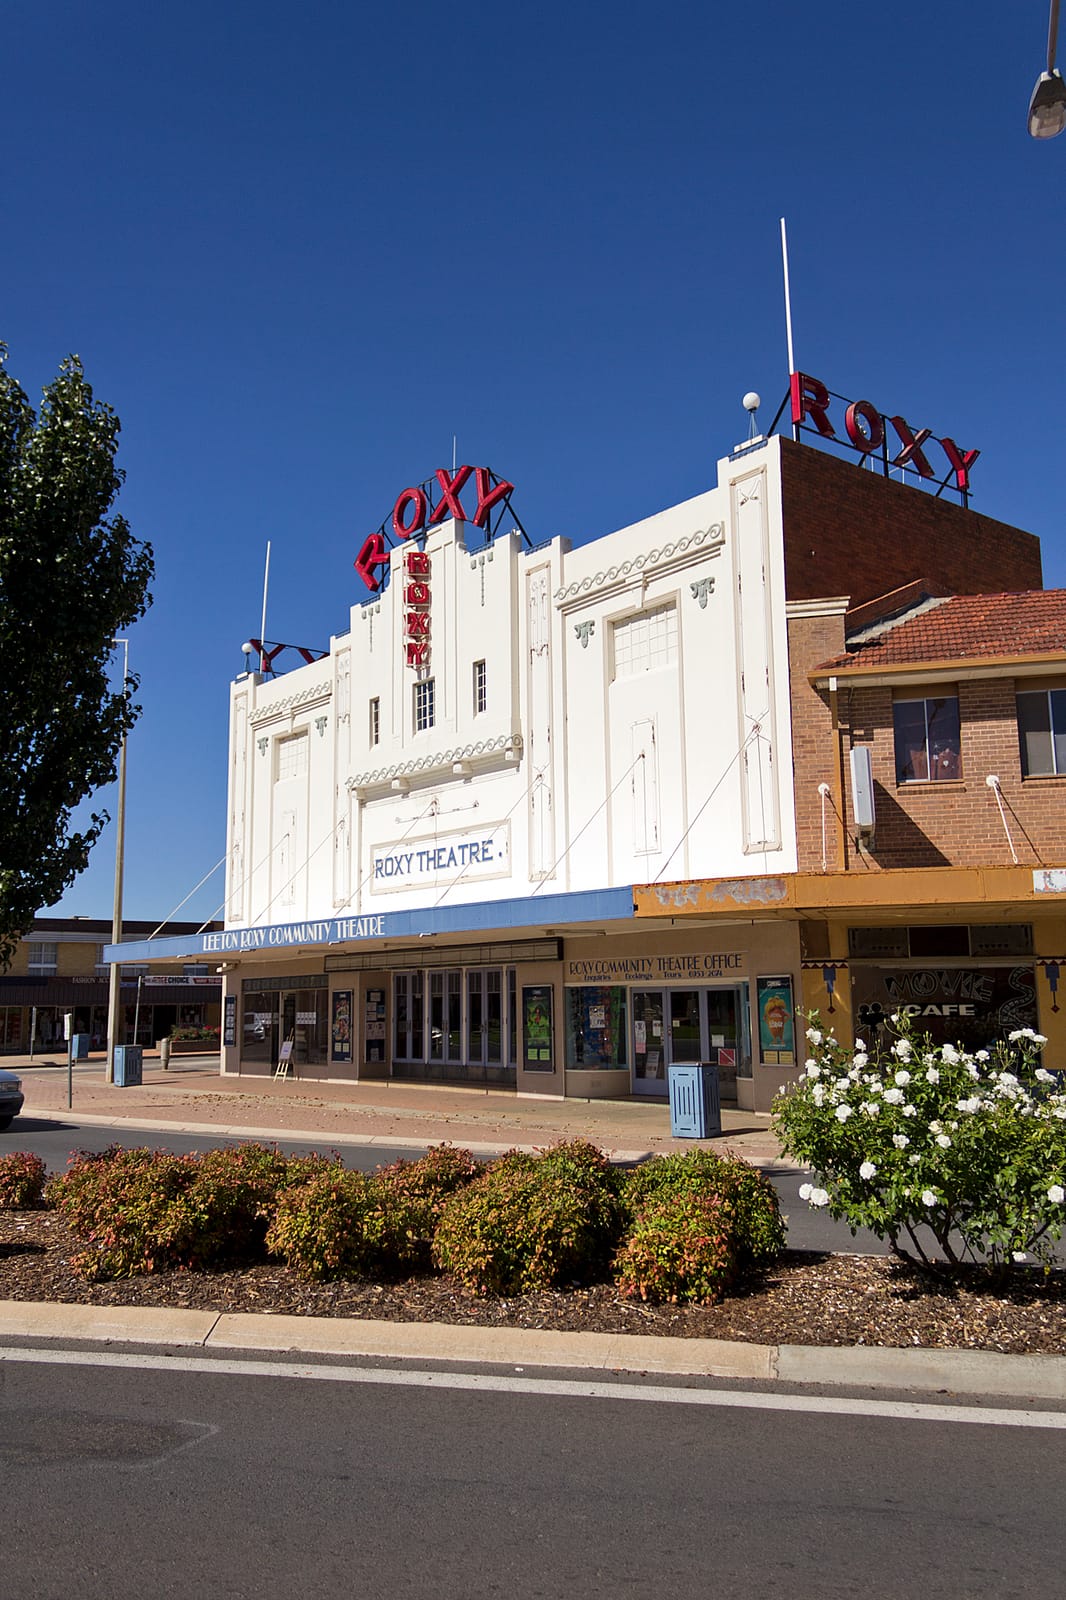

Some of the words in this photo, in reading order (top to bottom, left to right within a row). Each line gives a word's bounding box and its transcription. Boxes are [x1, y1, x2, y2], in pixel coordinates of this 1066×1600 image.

[790, 371, 980, 489] ROXY
[354, 465, 515, 593] ROXY
[404, 552, 431, 666] ROXY
[374, 853, 414, 878] ROXY
[202, 932, 238, 951] LEETON
[240, 929, 267, 948] ROXY
[269, 921, 332, 945] COMMUNITY
[335, 916, 385, 939] THEATRE
[569, 961, 594, 975] ROXY
[595, 959, 654, 974] COMMUNITY
[657, 955, 700, 971] THEATRE
[704, 954, 742, 969] OFFICE
[883, 970, 996, 1002] MOVIE
[906, 1004, 976, 1017] CAFE
